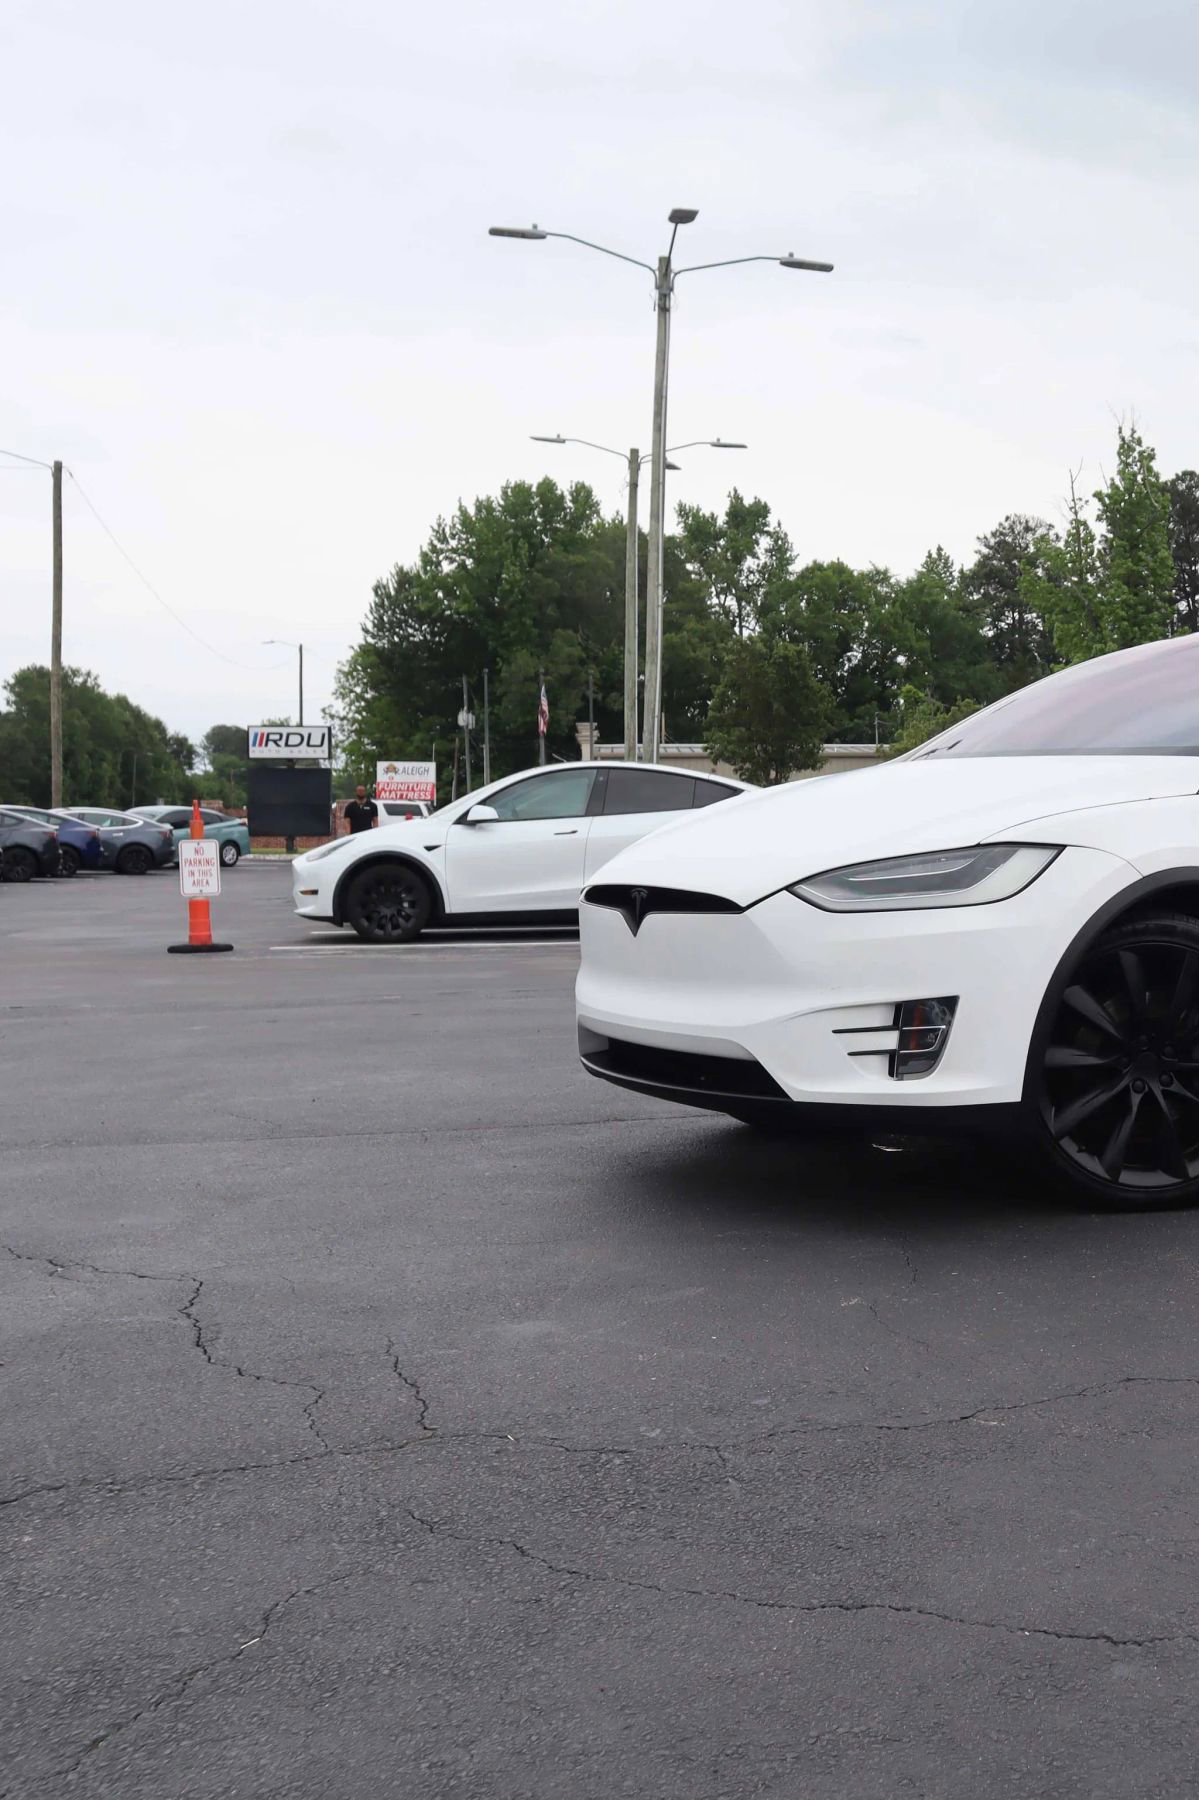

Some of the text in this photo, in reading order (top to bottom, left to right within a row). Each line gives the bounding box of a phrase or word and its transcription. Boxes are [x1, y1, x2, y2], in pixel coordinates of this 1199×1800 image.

[264, 732, 326, 748] RDU
[378, 783, 433, 791] FURNITURE
[380, 791, 432, 800] MATTRESS
[194, 847, 205, 856] NO
[184, 857, 216, 867] PARKING
[198, 869, 213, 877] THIS
[192, 879, 210, 887] AREA
